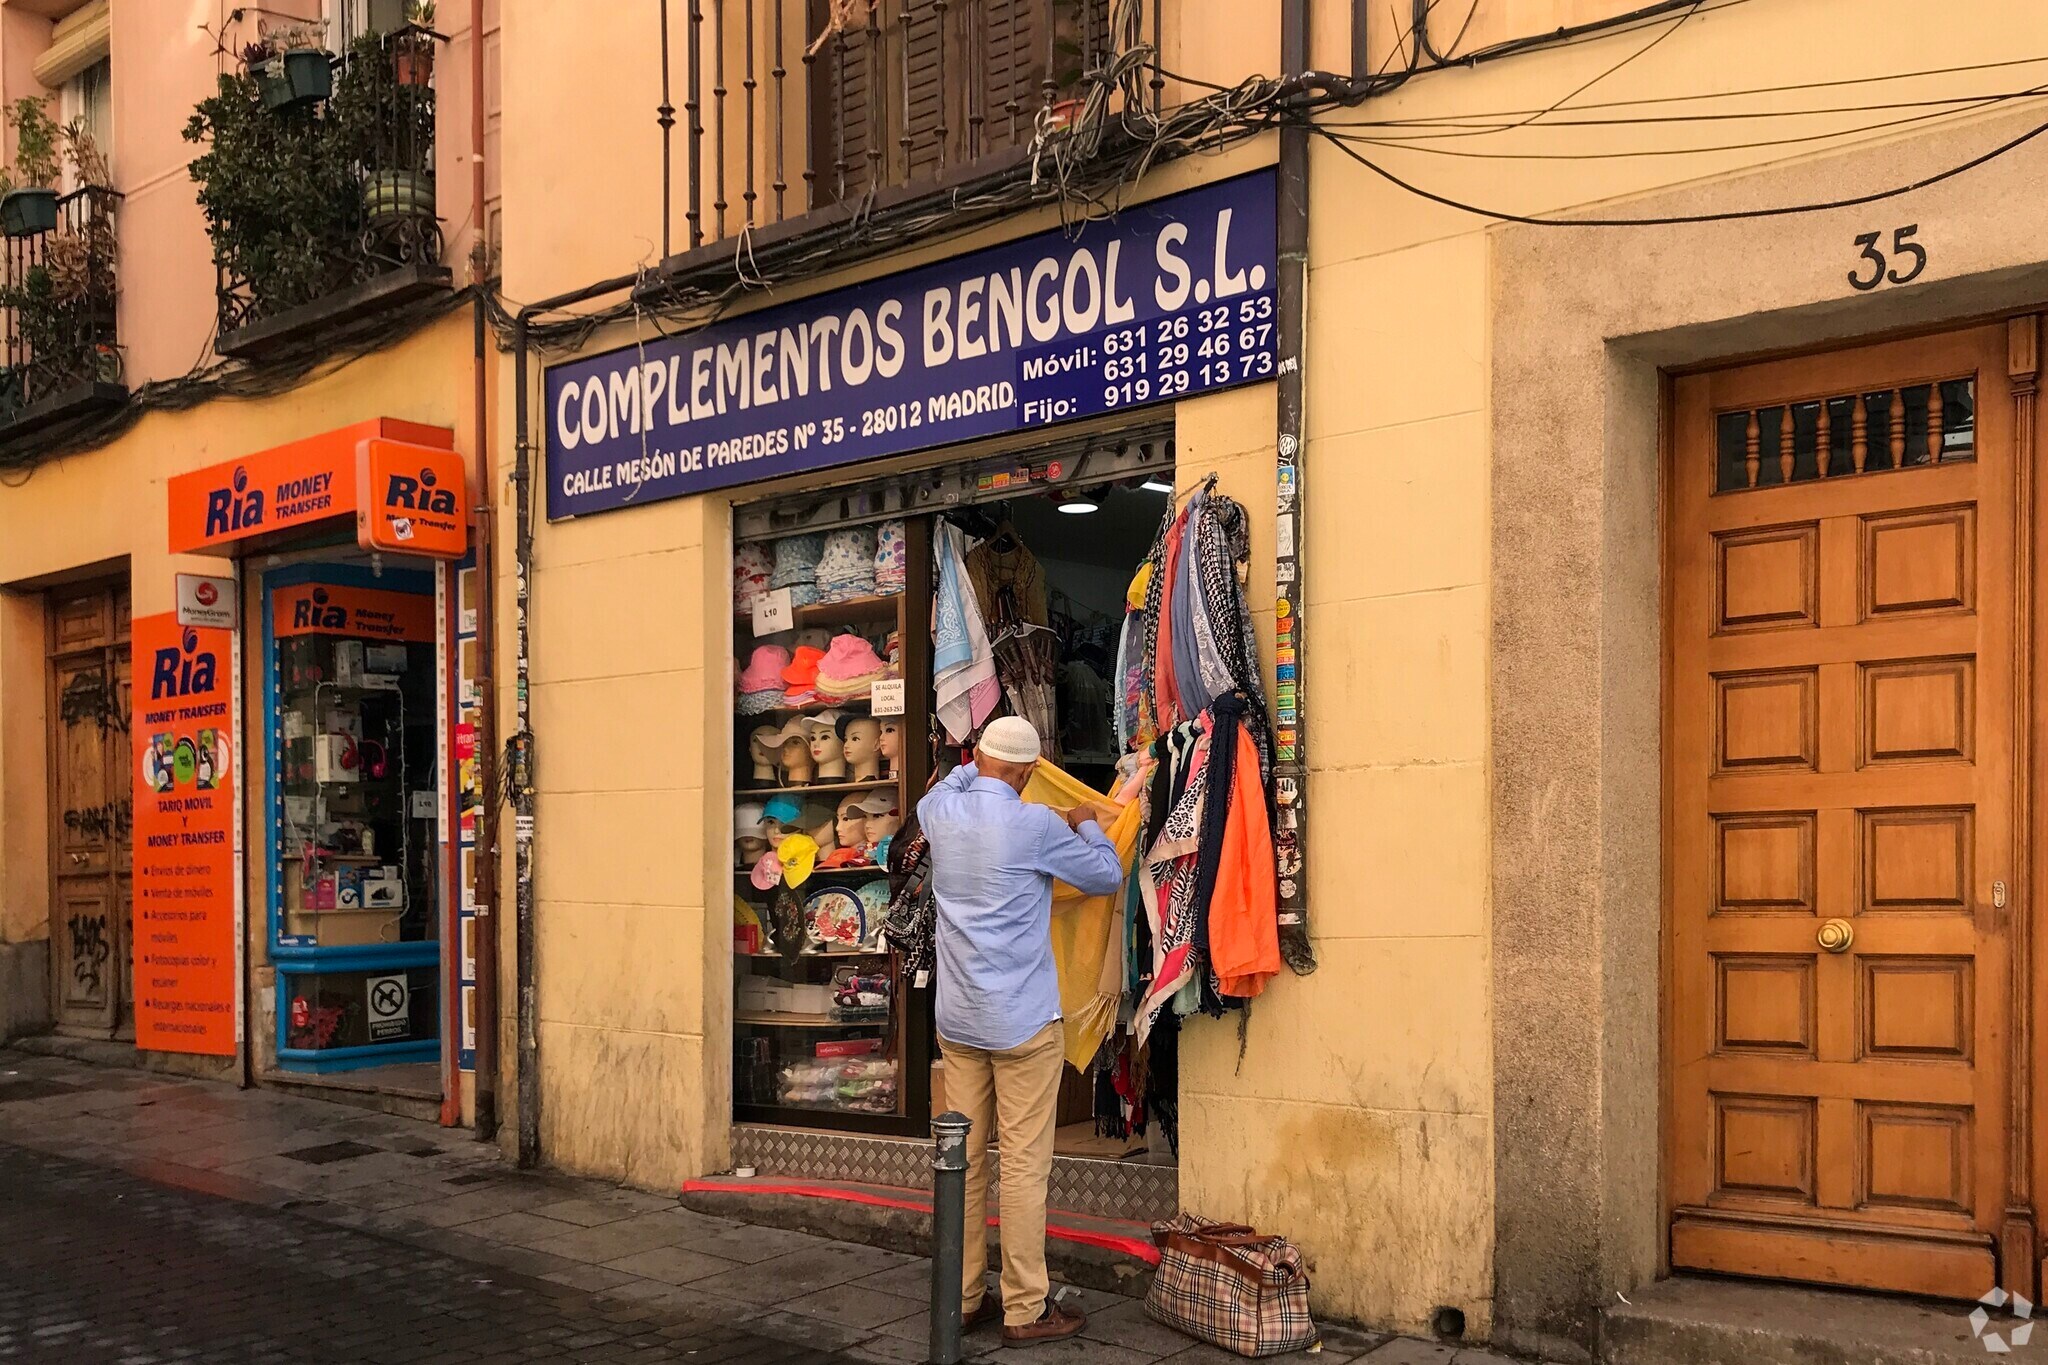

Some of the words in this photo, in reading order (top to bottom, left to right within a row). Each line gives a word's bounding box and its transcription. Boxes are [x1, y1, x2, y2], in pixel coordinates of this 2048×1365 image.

[1848, 224, 1926, 290] 35
[557, 299, 905, 450] COMPLEMENTOS
[923, 239, 1135, 368] BENGOL
[1155, 208, 1266, 312] S.L.
[1022, 347, 1097, 380] Móvil:
[1103, 326, 1146, 355] 631
[1157, 320, 1189, 343] 26
[1198, 306, 1229, 332] 32
[1239, 296, 1272, 323] 53
[1104, 353, 1147, 381] 631
[1158, 343, 1189, 369] 29
[1198, 333, 1230, 358] 46
[1239, 323, 1272, 350] 67
[1023, 397, 1076, 423] Fijo:
[1104, 378, 1150, 407] 919
[1158, 370, 1189, 396] 29
[1199, 361, 1230, 386] 13
[1239, 351, 1272, 377] 73
[563, 465, 612, 497] CALLE
[616, 448, 675, 486] MESÓN
[680, 446, 703, 473] DE
[707, 429, 789, 467] PAREDES
[821, 417, 844, 445] 35
[862, 400, 922, 437] 28012
[206, 465, 264, 537] Ria
[276, 472, 333, 503] MONEY
[276, 494, 331, 519] TRANSFER
[386, 467, 455, 516] Ria
[419, 518, 456, 531] Transfer
[294, 587, 347, 629] Ria
[355, 621, 405, 635] Transfer
[356, 608, 395, 621] Money
[152, 626, 216, 700] Ria
[145, 710, 176, 724] MONEY
[179, 703, 226, 720] TRANSFER
[157, 800, 182, 813] TARIQ
[182, 815, 188, 827] Y
[148, 834, 178, 847] MONEY
[181, 830, 225, 845] TRANSFER
